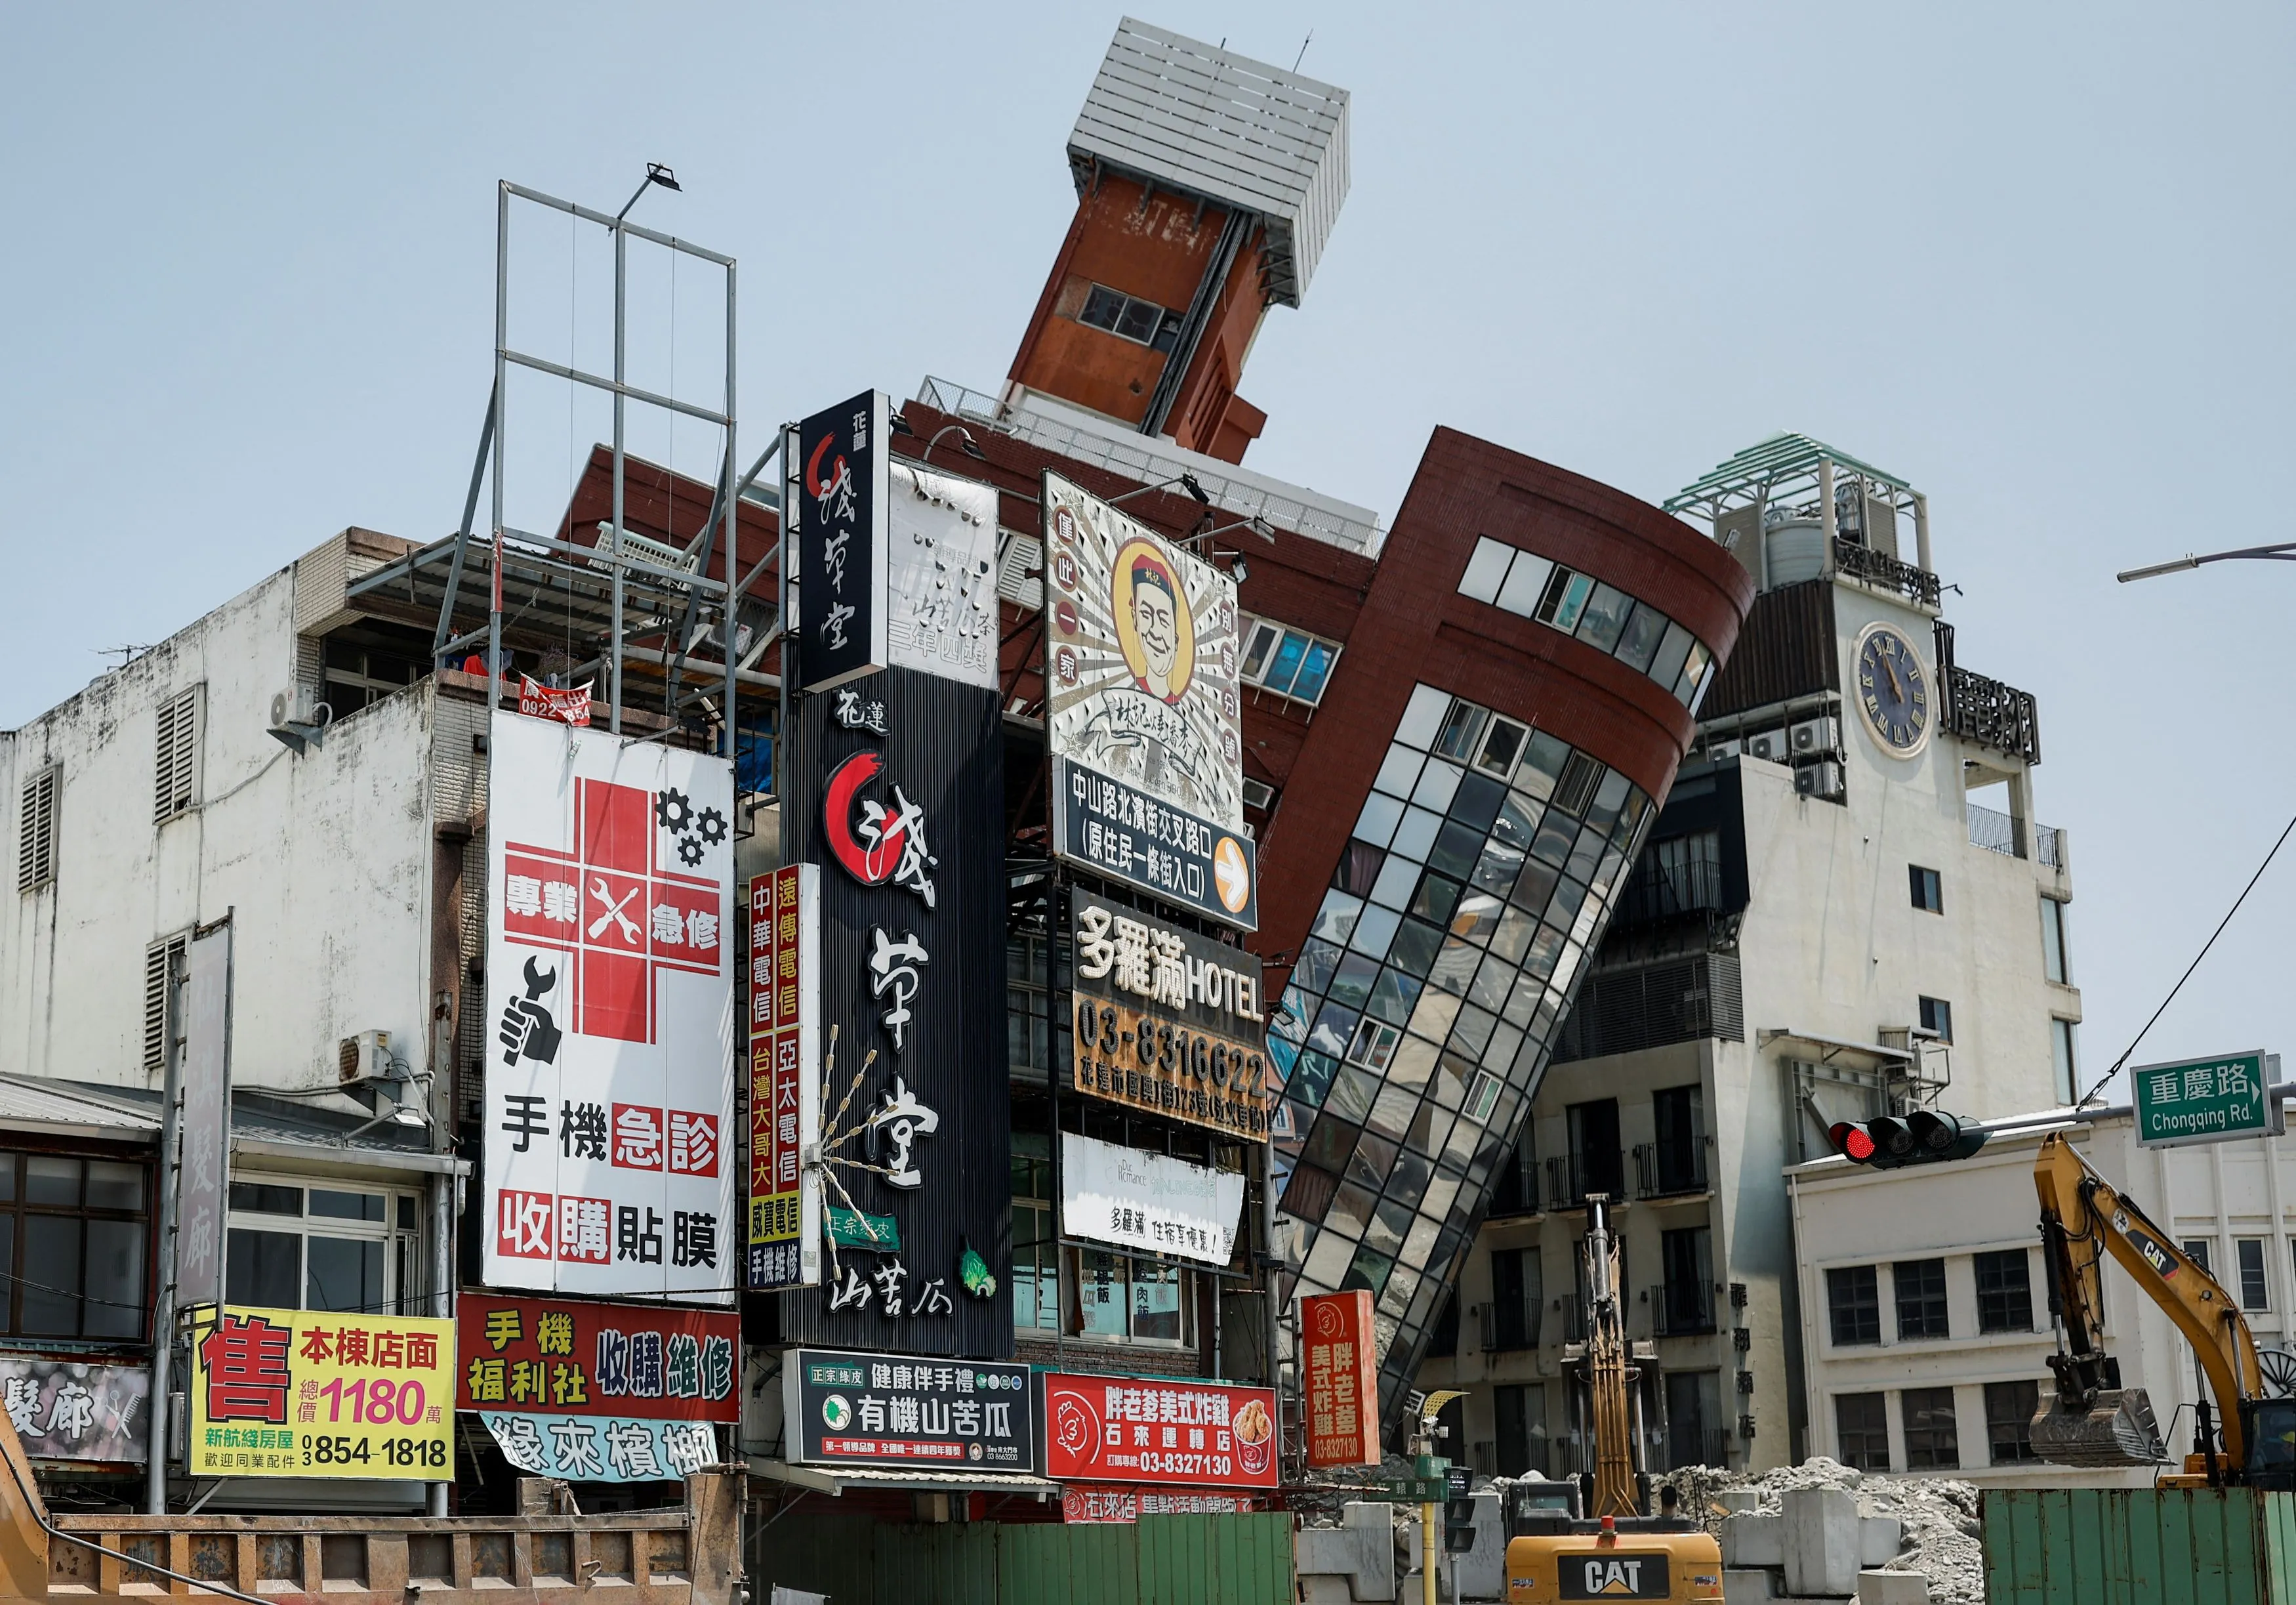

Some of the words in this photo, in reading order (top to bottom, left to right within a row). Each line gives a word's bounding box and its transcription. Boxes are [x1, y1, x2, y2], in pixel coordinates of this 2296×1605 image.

[853, 410, 867, 452] 花蓮
[1057, 512, 1077, 680] 僅此一家
[1221, 608, 1237, 761] 別無分號
[522, 699, 556, 717] 0922
[837, 689, 889, 732] 花蓮
[1073, 769, 1212, 860] 中山路北濱街交叉路口
[1082, 818, 1205, 901] (原住民一條街入口)
[506, 875, 578, 924] 專業
[651, 904, 719, 949] 急修
[752, 885, 771, 1024] 中華電信
[778, 877, 796, 1017] 遠傳電信
[1079, 999, 1265, 1098] 03-8316622
[2150, 1063, 2248, 1104] 重慶路
[502, 1094, 716, 1172] 手機急診
[752, 1047, 771, 1188] 台灣大哥大
[778, 1039, 796, 1183] 亞太電信
[2152, 1107, 2226, 1133] Chongqing
[2230, 1103, 2253, 1123] Rd.
[502, 1193, 717, 1269] 收購貼膜
[752, 1197, 798, 1239] 威寶電信
[1110, 1206, 1147, 1239] 多羅滿
[752, 1243, 798, 1285] 手機維修
[2144, 1240, 2167, 1270] CAT
[830, 1259, 953, 1314] 山苦瓜
[198, 1314, 293, 1425] 售
[300, 1326, 439, 1370] 本棟店面
[485, 1309, 574, 1356] 手機
[596, 1329, 733, 1400] 收購維修
[297, 1379, 319, 1423] 總價
[319, 1377, 426, 1425] 1180
[426, 1406, 443, 1424] 萬
[468, 1358, 587, 1404] 福利社
[811, 1368, 863, 1386] 正宗綠皮
[871, 1363, 975, 1394] 健康伴手禮
[1311, 1345, 1334, 1436] 美式炸雞
[1333, 1342, 1357, 1435] 胖老爹
[4, 1377, 95, 1439] 髮廊
[857, 1394, 1012, 1438] 有機山苦瓜
[1105, 1386, 1230, 1427] 胖老爹美式炸雞
[314, 1435, 447, 1467] 854-1818
[493, 1417, 719, 1478] 緣來檳榔
[825, 1441, 876, 1453] 第一領導品牌
[1105, 1423, 1231, 1451] 石來運轉店
[1315, 1437, 1357, 1459] 03-8327130
[205, 1452, 295, 1469] 歡迎同業配件
[1140, 1451, 1231, 1476] 03-8327130
[1085, 1492, 1137, 1520] 石來店
[1585, 1560, 1642, 1595] CAT
